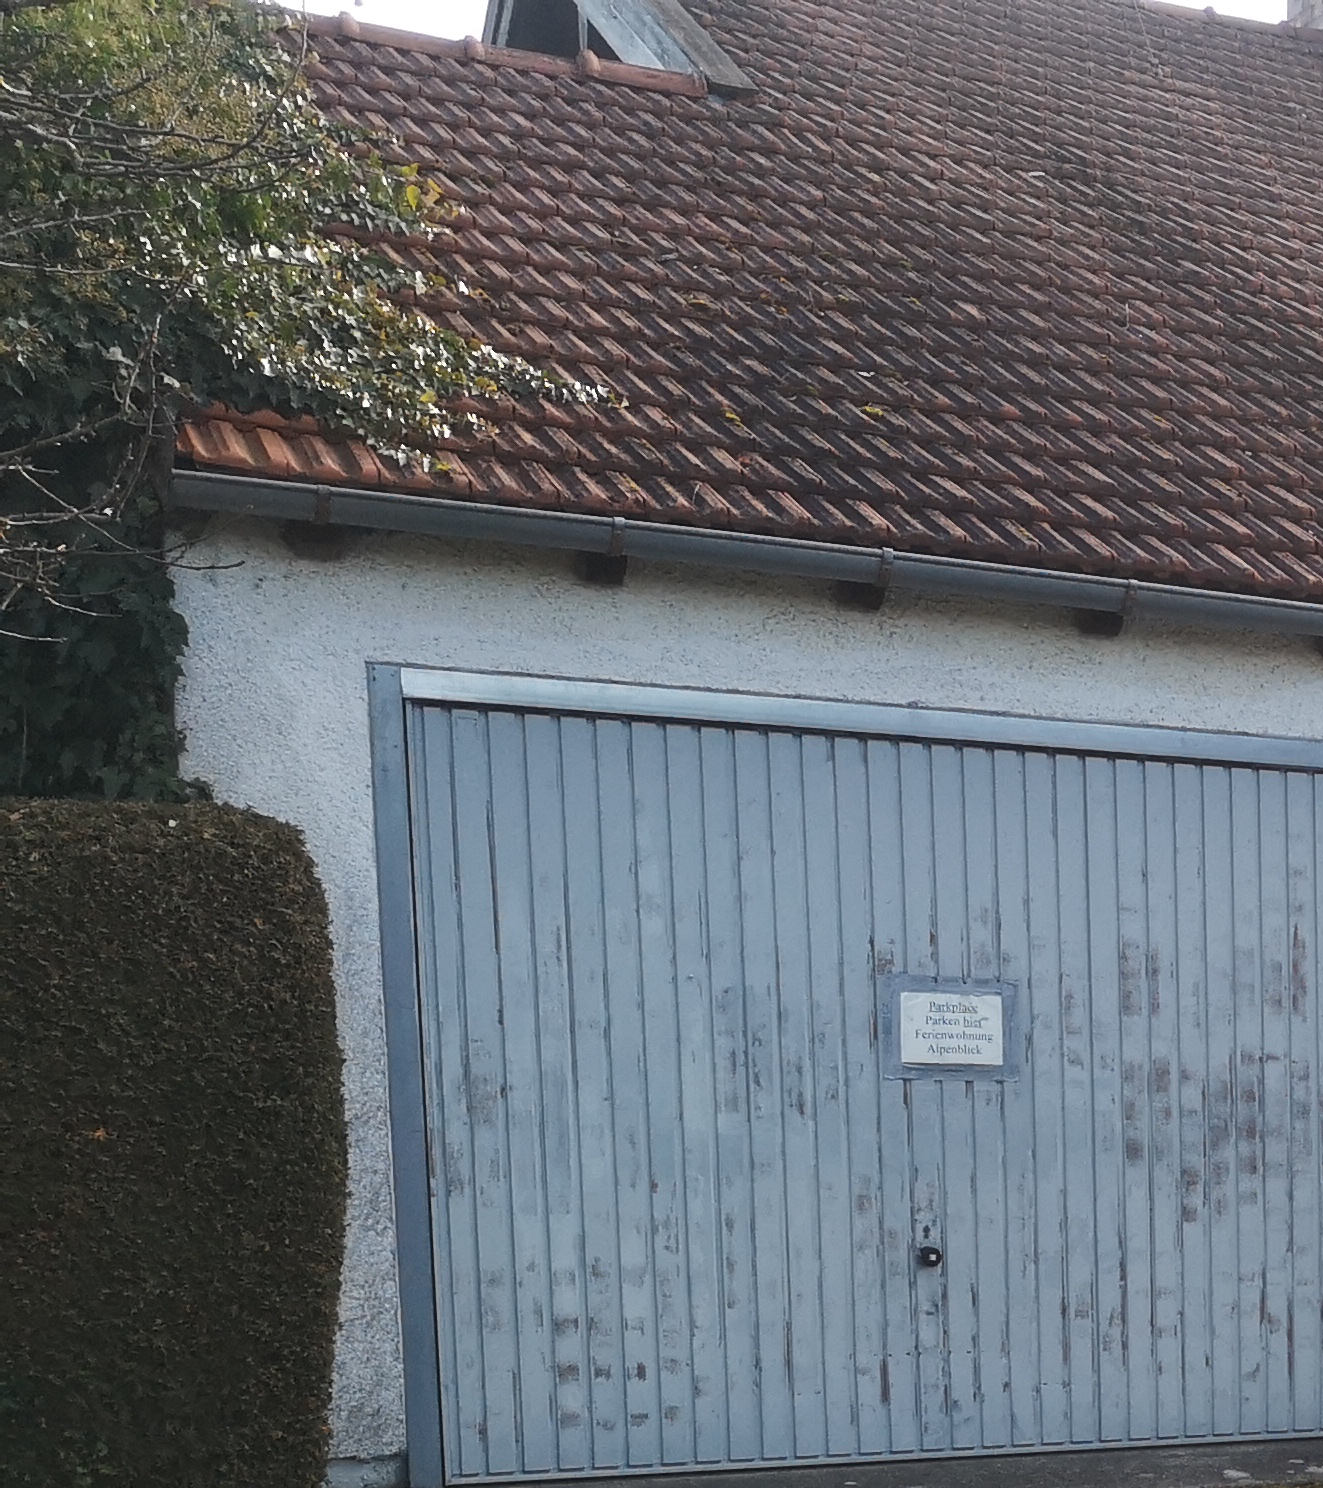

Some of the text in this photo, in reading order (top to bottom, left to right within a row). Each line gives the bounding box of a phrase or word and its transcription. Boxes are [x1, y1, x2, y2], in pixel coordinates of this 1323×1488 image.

[925, 1015, 960, 1026] Parken
[915, 1029, 994, 1043] Ferienwohnung
[927, 1044, 983, 1056] Alpenblick
